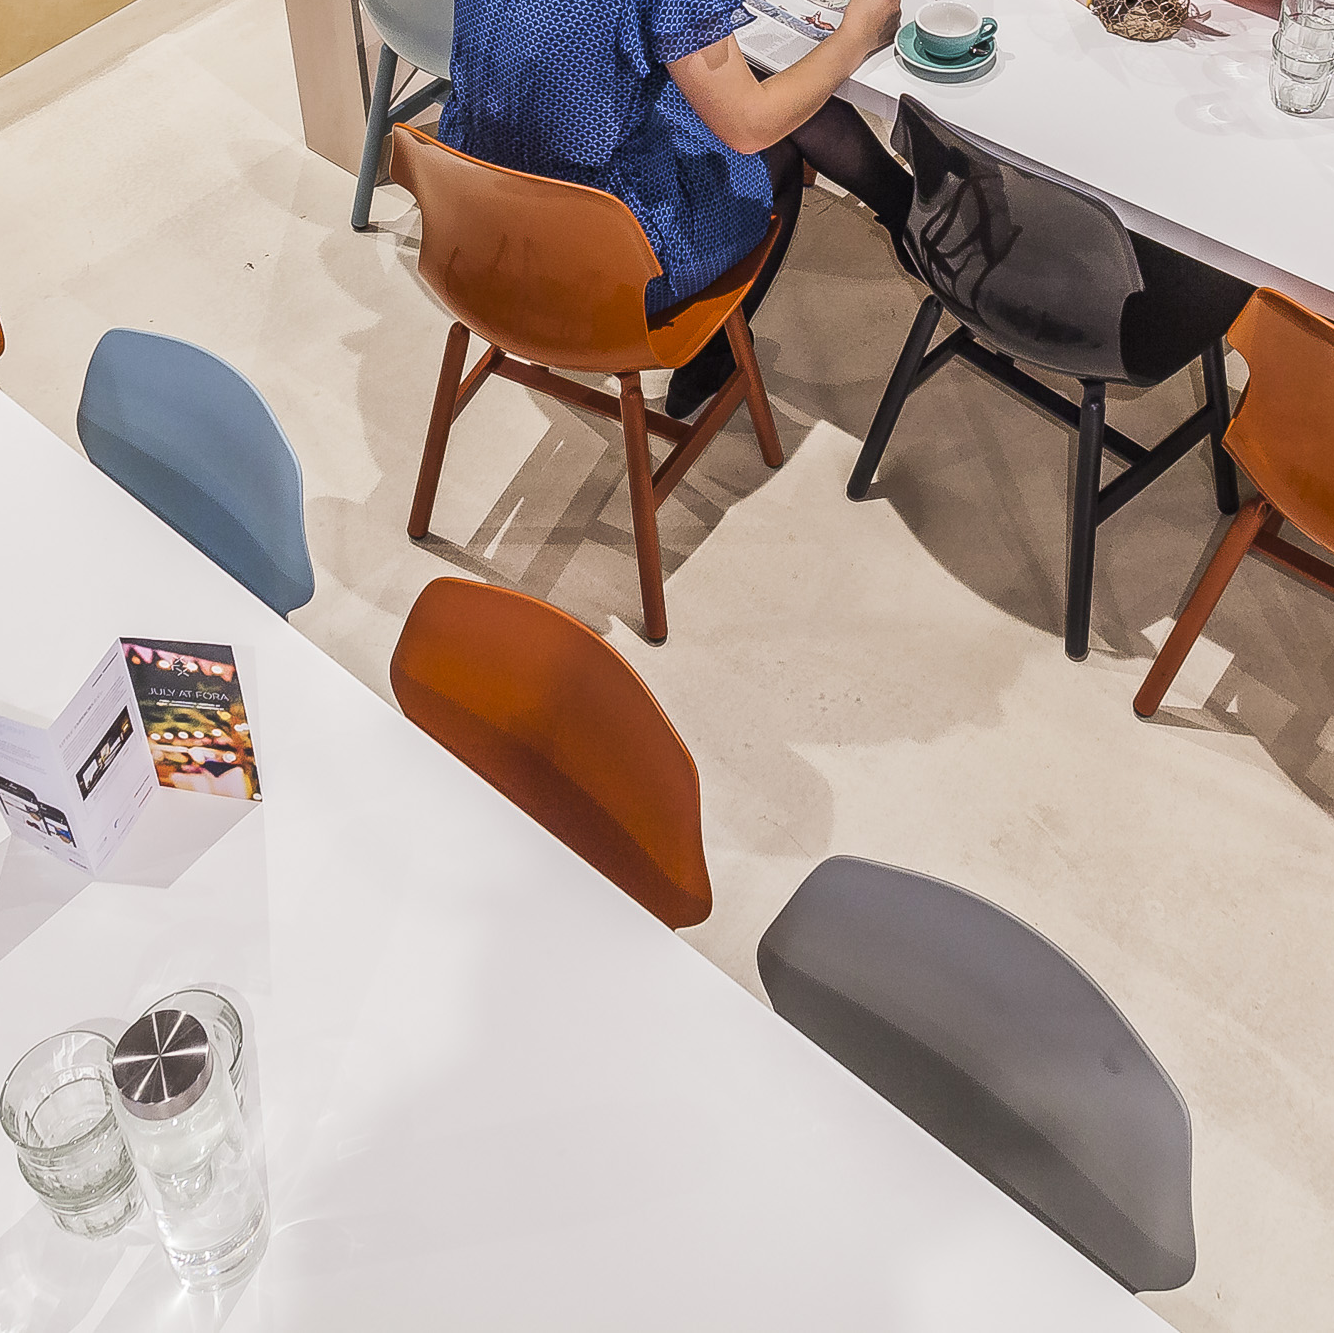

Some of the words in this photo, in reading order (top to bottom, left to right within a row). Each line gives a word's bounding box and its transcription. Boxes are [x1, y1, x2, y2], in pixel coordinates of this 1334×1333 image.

[147, 687, 176, 697] JULY
[178, 689, 193, 699] AT
[195, 691, 230, 702] FORA
